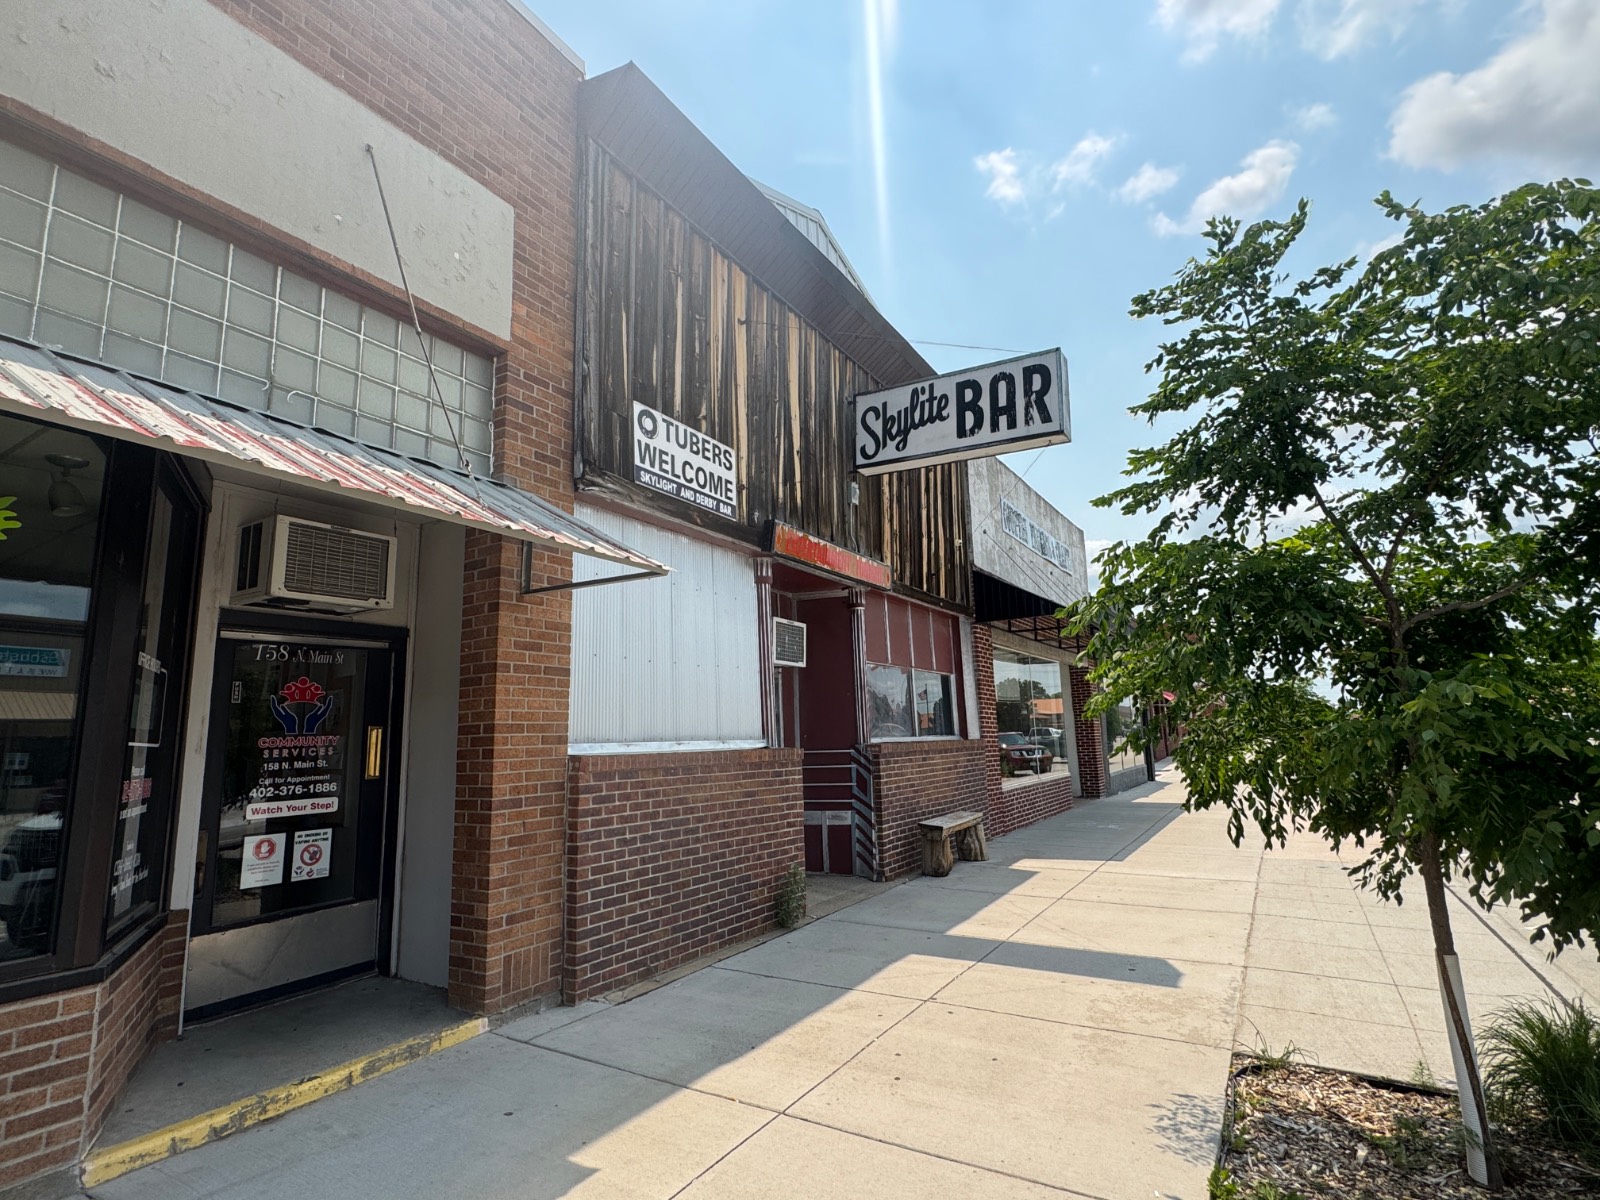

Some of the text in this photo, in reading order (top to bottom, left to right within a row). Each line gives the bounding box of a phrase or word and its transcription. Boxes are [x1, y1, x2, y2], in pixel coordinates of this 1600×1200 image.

[859, 362, 1053, 461] Skylite BAR
[661, 417, 733, 472] TUBERS
[637, 439, 734, 502] WELCOME
[640, 470, 733, 516] SKYLIGHT AND DERBY BAR
[308, 649, 333, 664] Main
[335, 651, 344, 664] St
[258, 735, 340, 748] COMMUNITY
[263, 747, 334, 759] SERVICES
[263, 759, 329, 771] 158 N. Main St.
[258, 777, 273, 785] Call
[249, 782, 338, 798] 402-376-1886
[251, 801, 335, 816] Watch Your Step!
